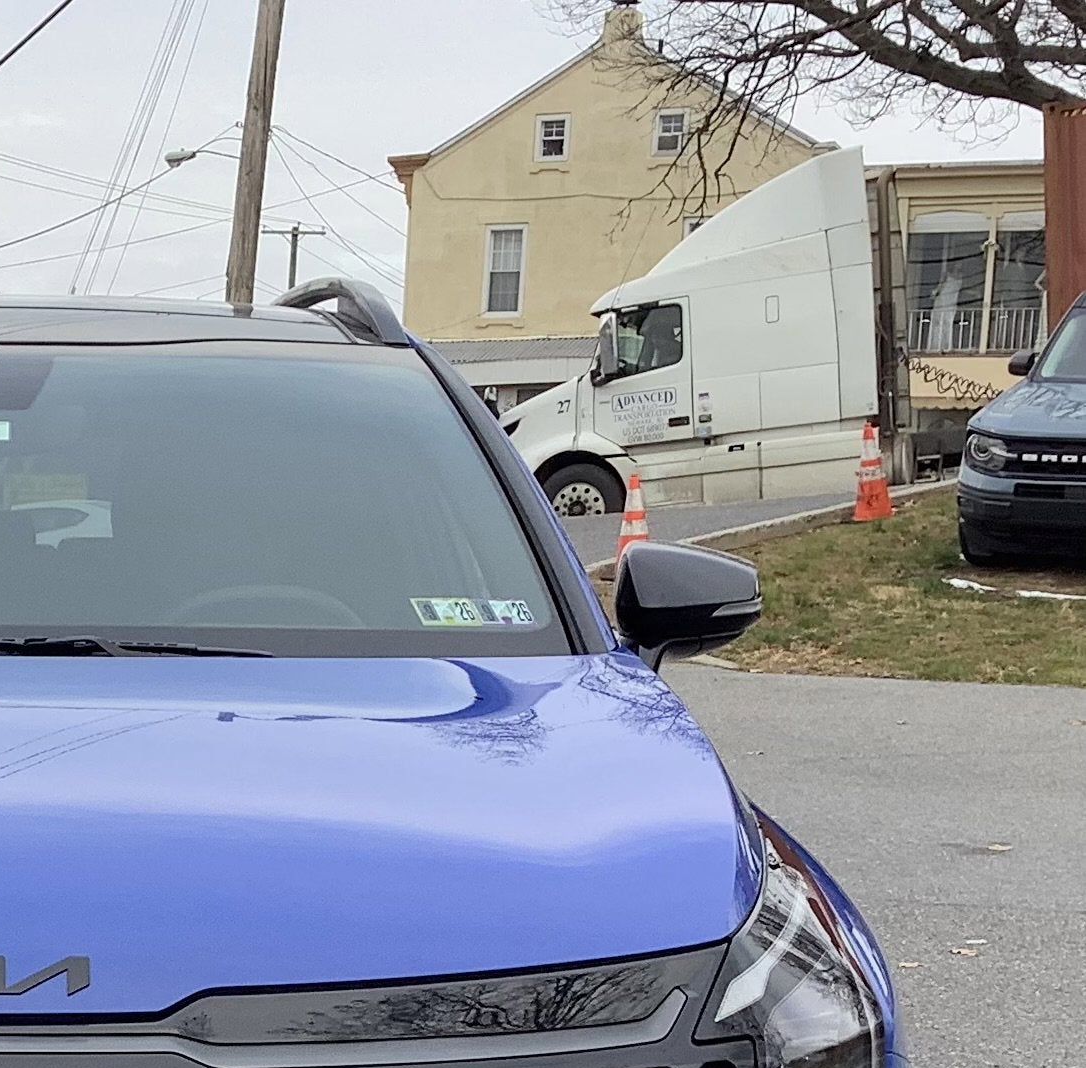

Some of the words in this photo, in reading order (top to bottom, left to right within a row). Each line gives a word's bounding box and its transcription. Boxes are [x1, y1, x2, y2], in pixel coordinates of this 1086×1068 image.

[557, 399, 571, 414] 27
[615, 391, 674, 409] ADVANCED
[1022, 453, 1086, 463] BRO
[454, 601, 476, 621] 26
[511, 602, 533, 622] 26
